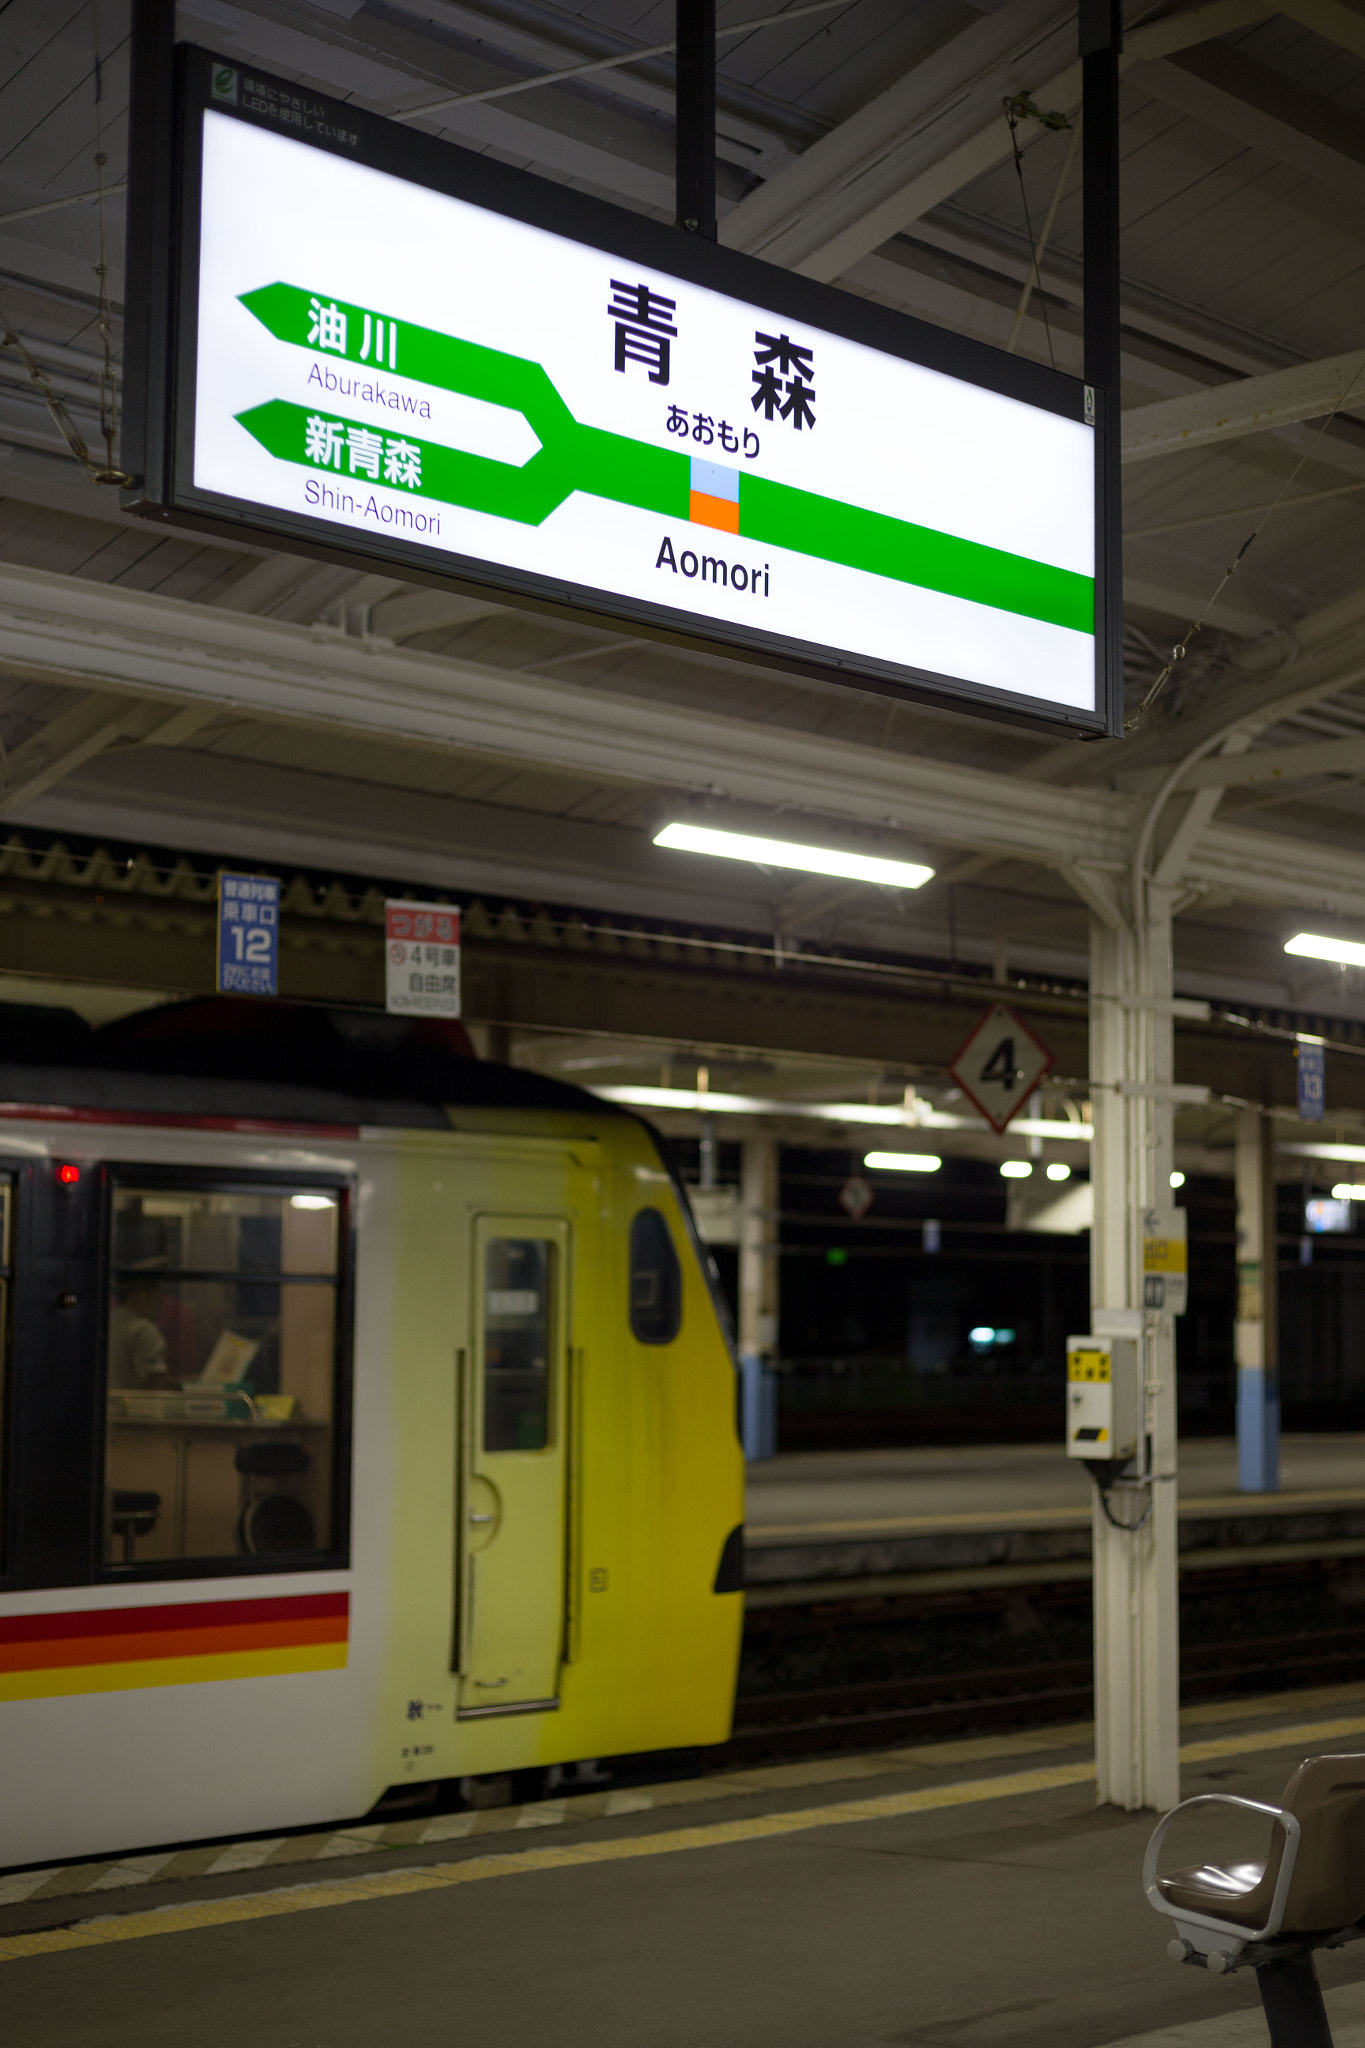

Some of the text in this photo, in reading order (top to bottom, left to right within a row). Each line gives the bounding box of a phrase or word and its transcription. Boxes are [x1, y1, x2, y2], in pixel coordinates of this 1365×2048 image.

[242, 93, 360, 146] LEDを使用しています
[307, 297, 398, 370] 油川
[607, 277, 817, 431] 青森
[307, 362, 432, 420] Aburakawa
[304, 414, 423, 489] 新青森
[666, 404, 760, 459] あおもり
[304, 479, 441, 535] Shin-Aomori
[655, 535, 770, 598] Aomori
[230, 925, 272, 964] 12
[391, 913, 455, 941] つがる
[980, 1036, 1017, 1090] 4
